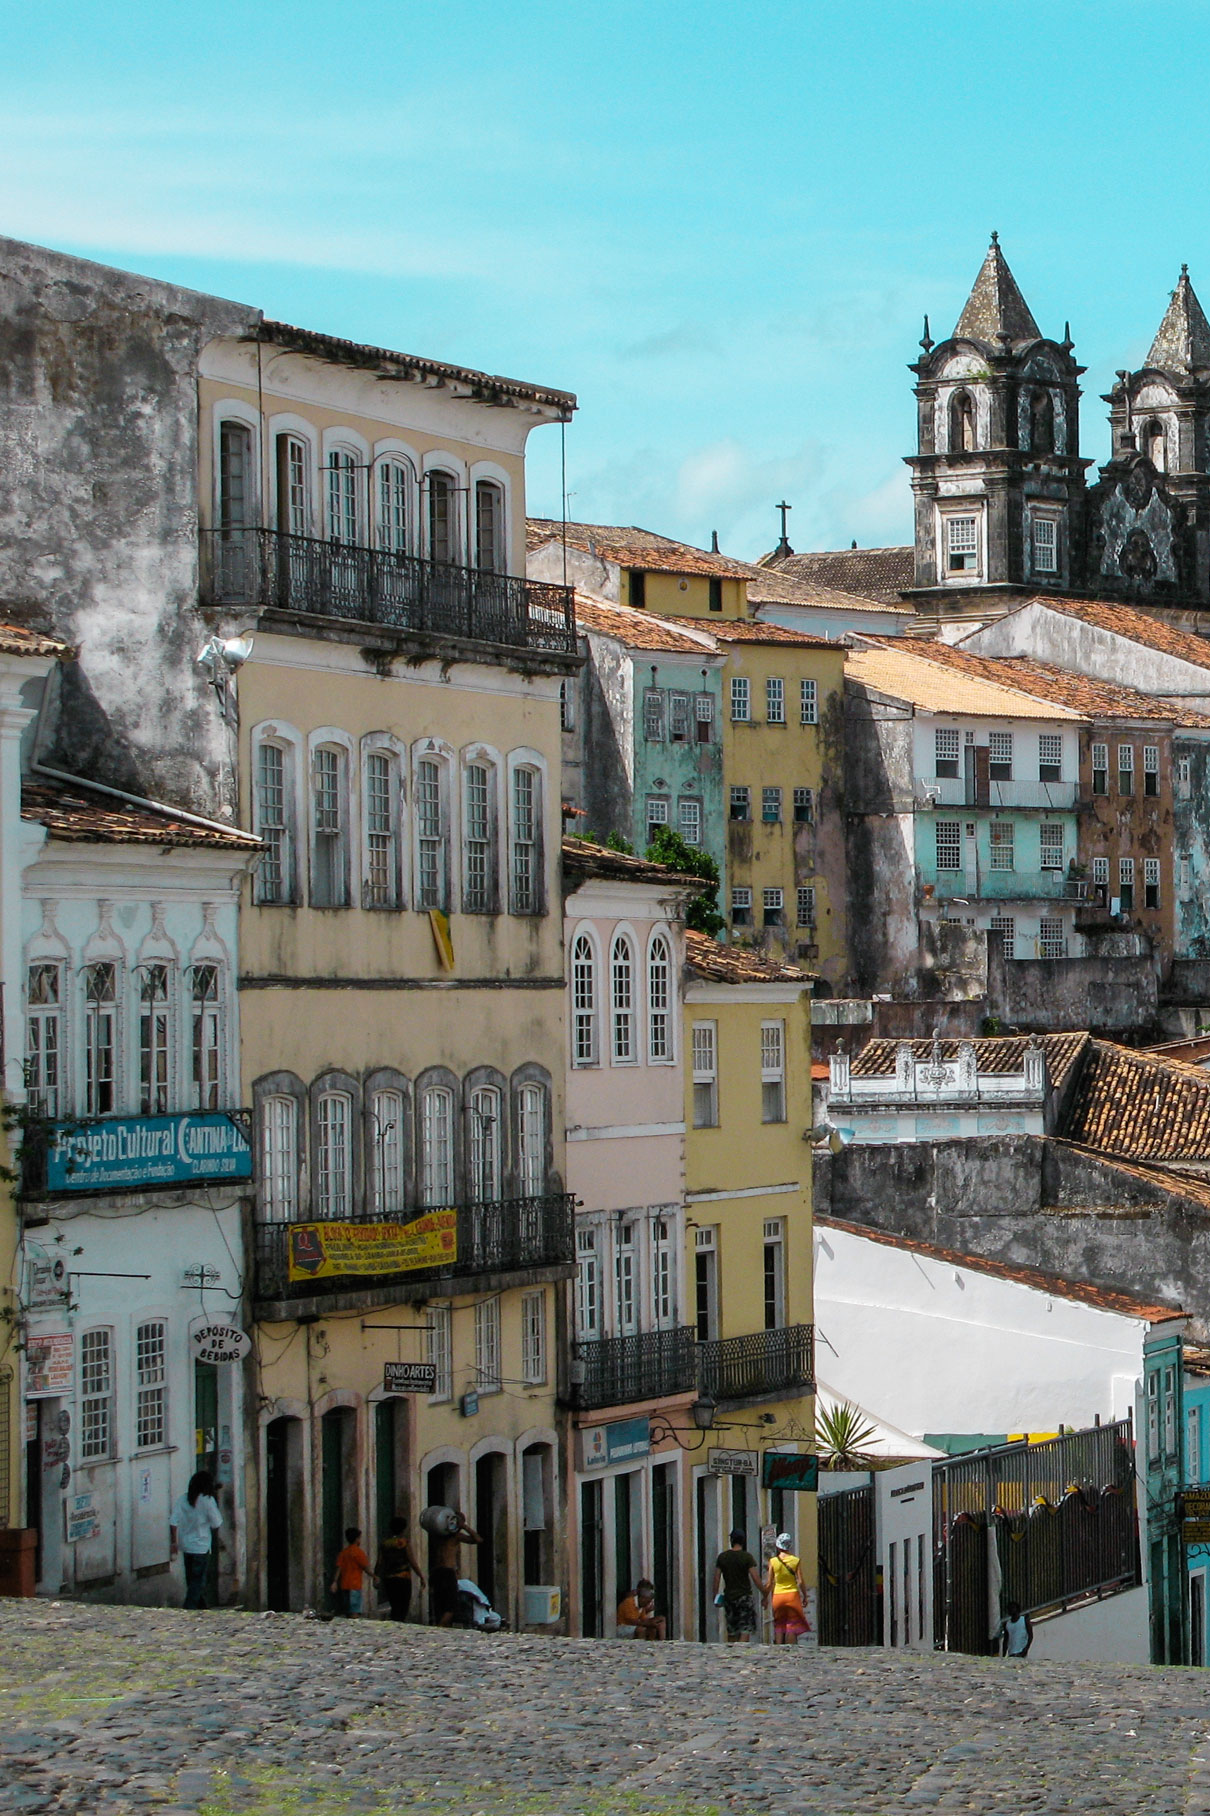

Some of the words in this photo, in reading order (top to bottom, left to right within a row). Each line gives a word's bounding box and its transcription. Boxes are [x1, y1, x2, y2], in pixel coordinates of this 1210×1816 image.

[54, 1129, 116, 1168] Projeto
[117, 1121, 174, 1160] Cultural
[211, 1339, 225, 1349] DE
[200, 1348, 240, 1361] BEBIDAS
[385, 1364, 410, 1378] DINHO
[410, 1365, 435, 1379] ARTES
